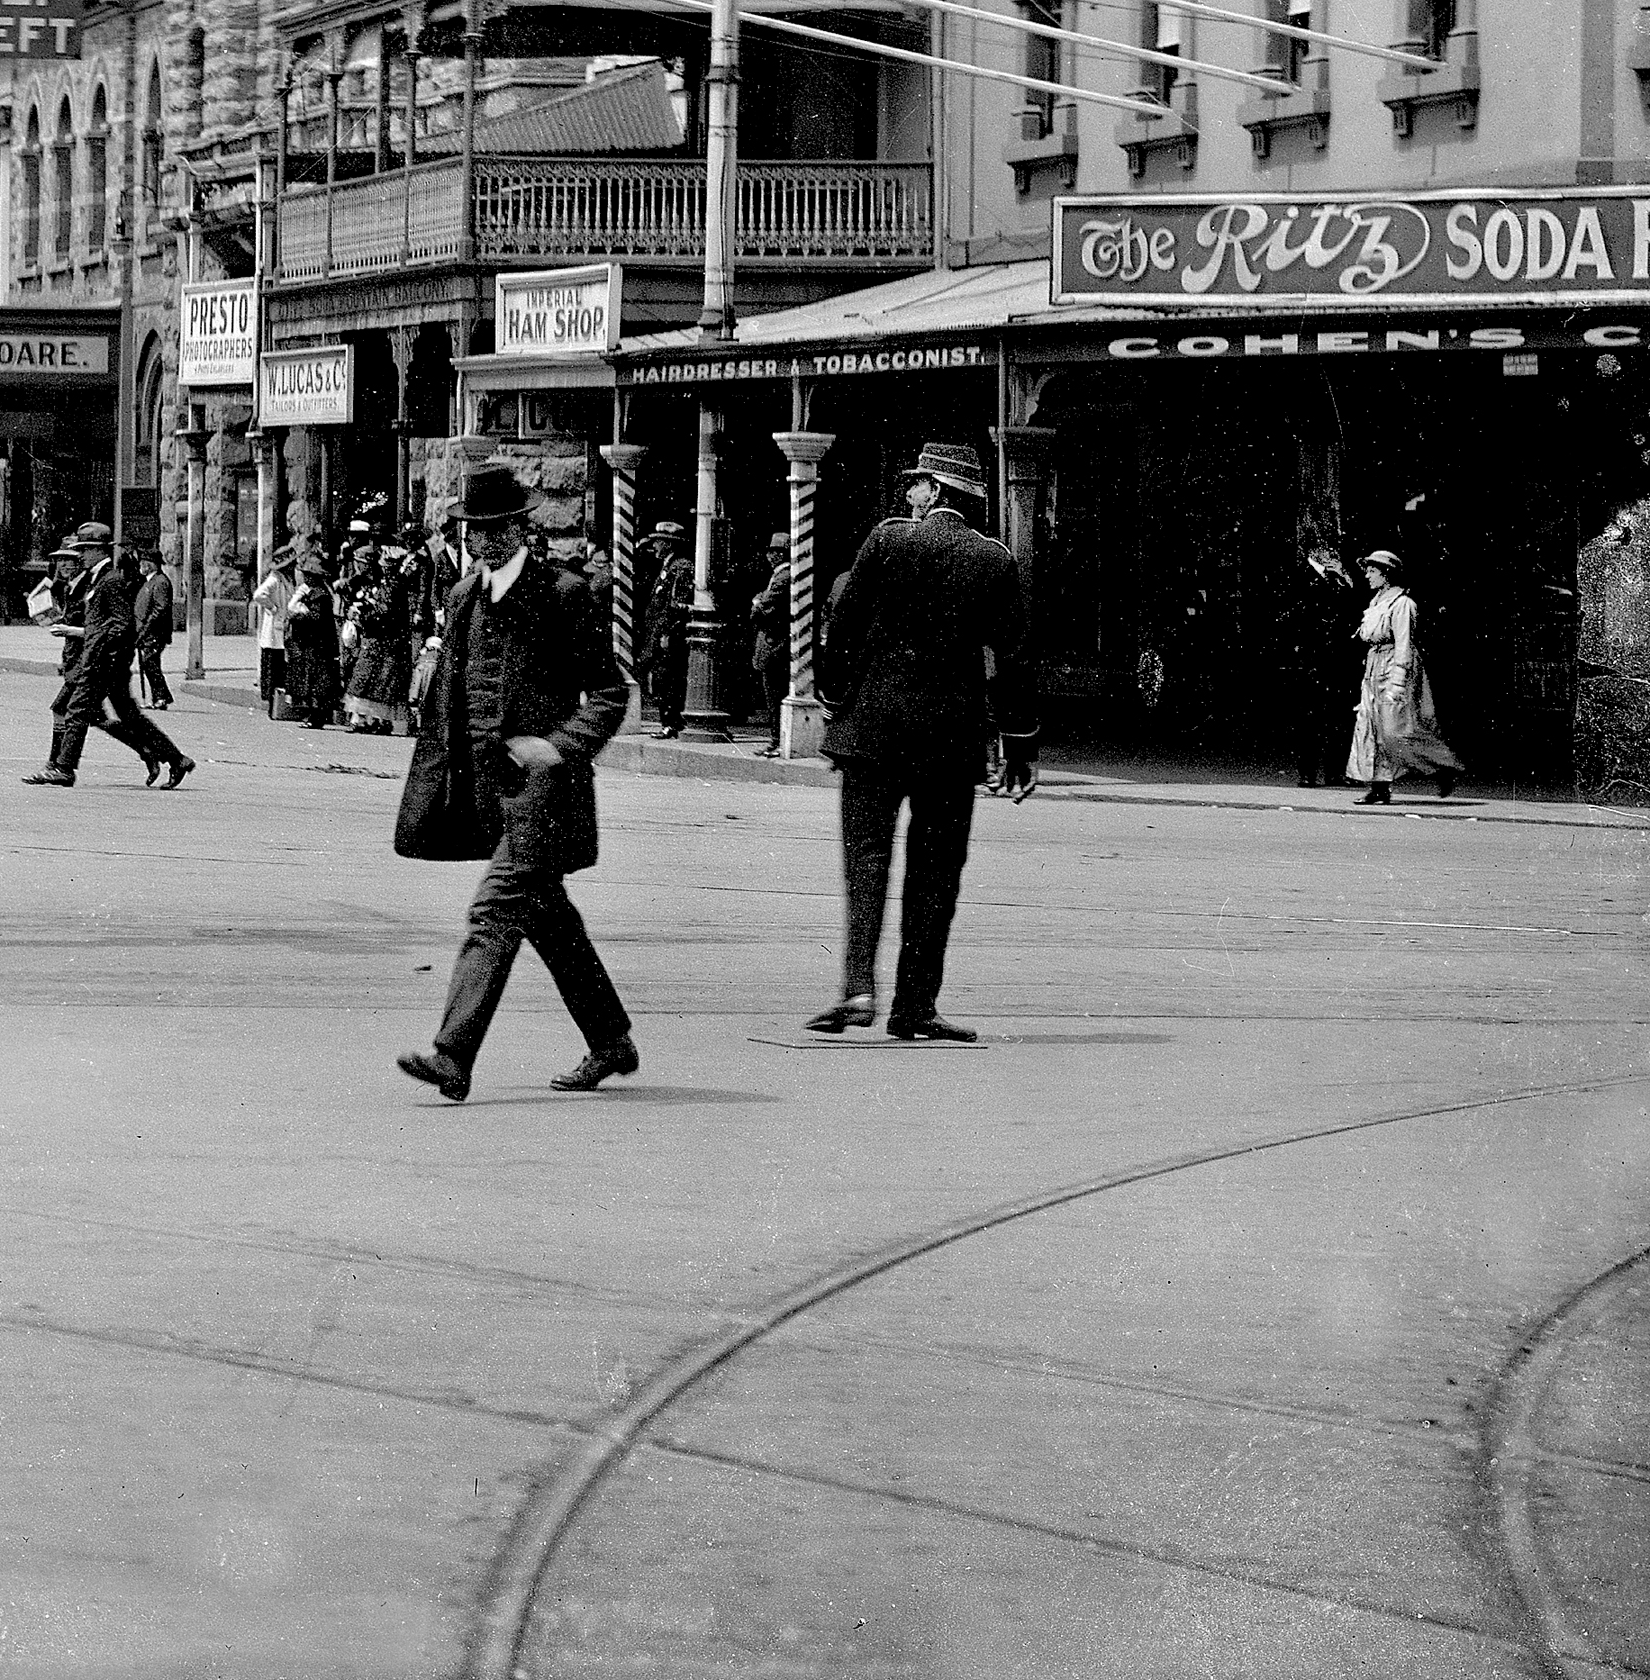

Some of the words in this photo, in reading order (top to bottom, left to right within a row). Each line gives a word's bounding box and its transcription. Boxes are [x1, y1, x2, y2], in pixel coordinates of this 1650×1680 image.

[1078, 217, 1177, 282] The
[1180, 202, 1431, 295] Ritz
[1446, 203, 1615, 282] SODA
[526, 289, 583, 309] IMPERIAL
[508, 308, 548, 344] HAM
[1108, 326, 1526, 359] COHEN'S
[184, 338, 253, 362] PHOTOGRAPHERS
[632, 358, 778, 384] HAIRDRESSER
[813, 346, 986, 375] TOBACCONIST.
[325, 369, 332, 392] &
